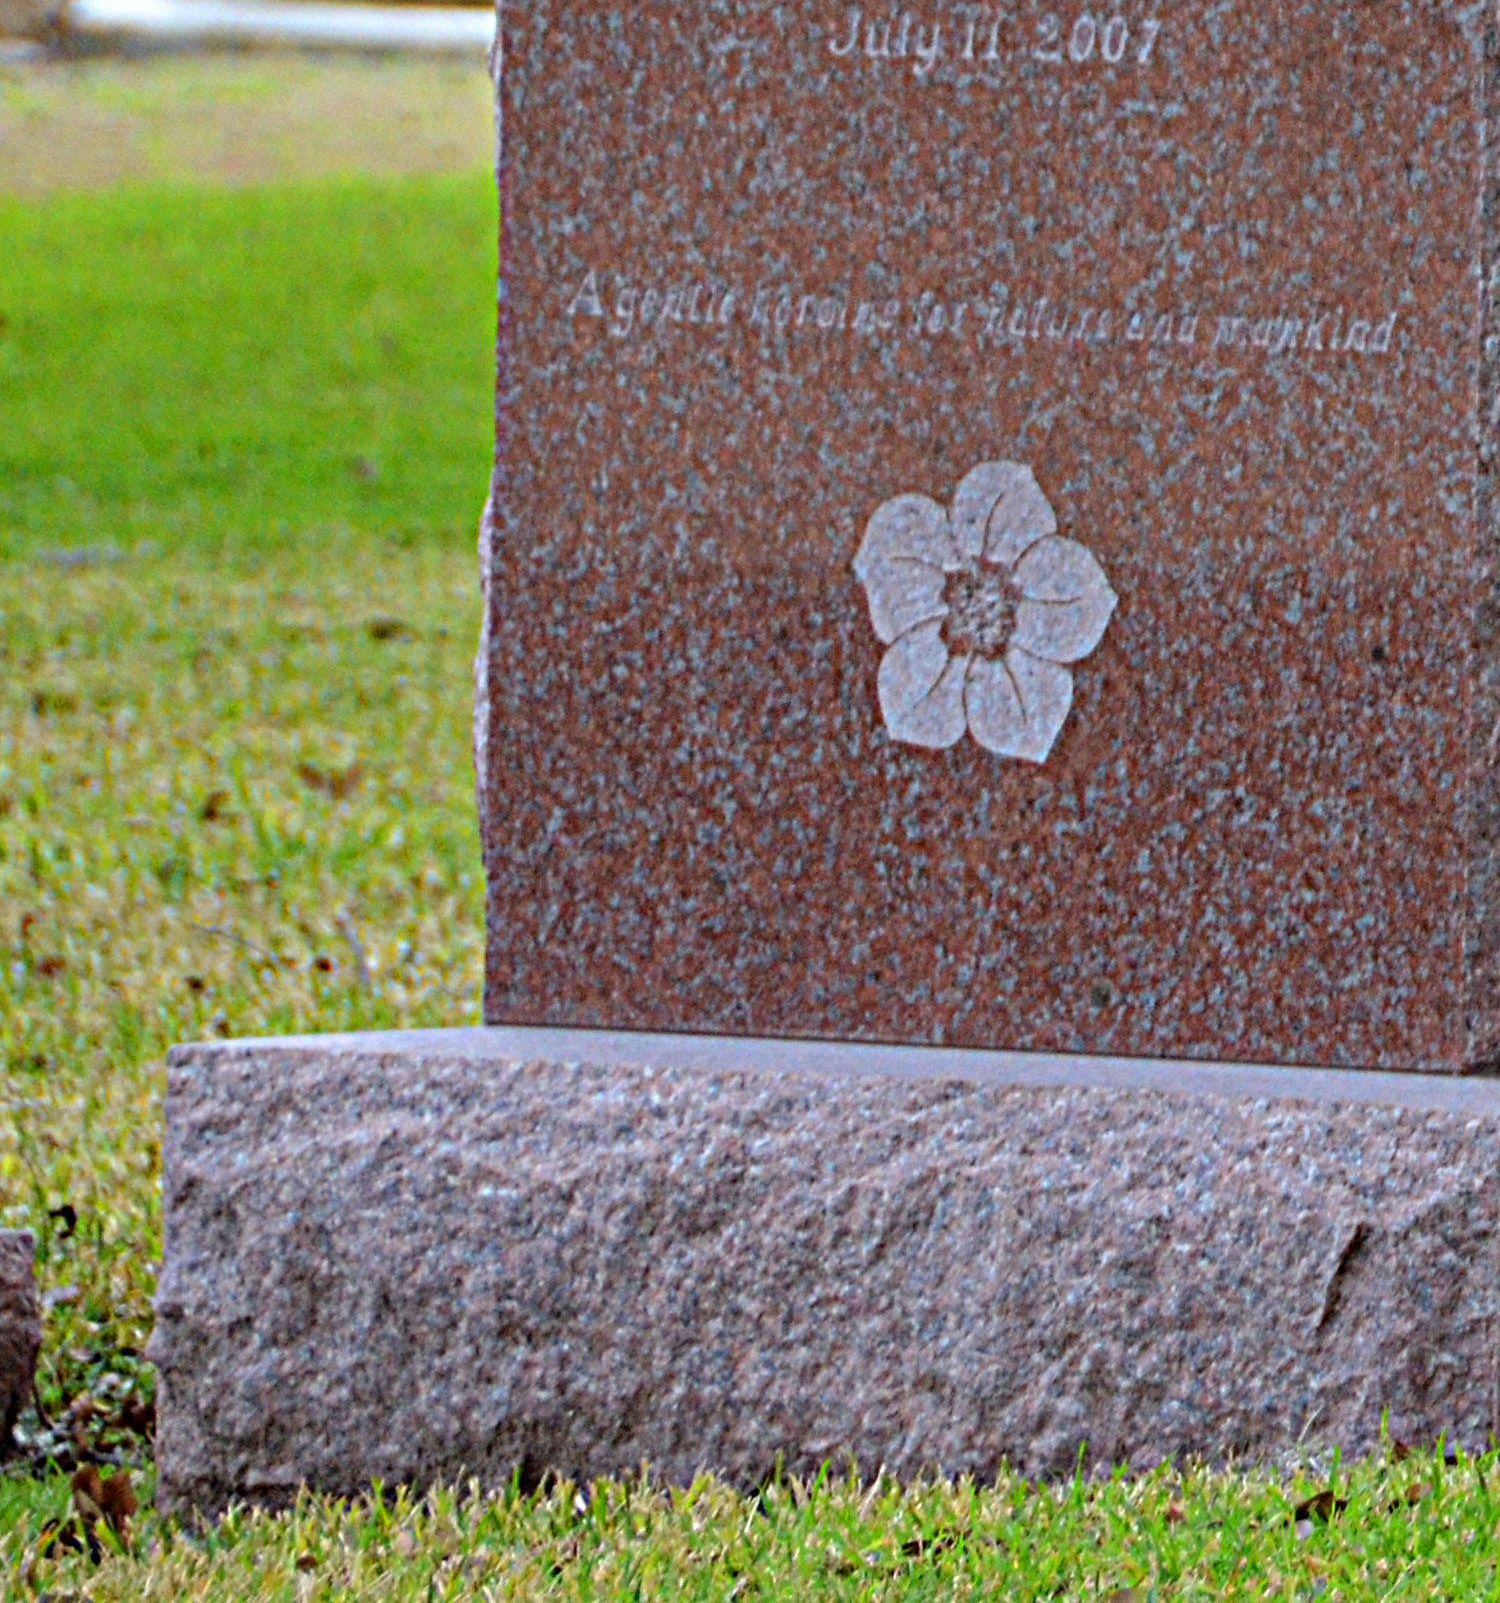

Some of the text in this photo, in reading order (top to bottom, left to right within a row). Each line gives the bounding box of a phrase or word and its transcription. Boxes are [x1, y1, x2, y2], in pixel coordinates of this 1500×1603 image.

[829, 4, 941, 76] July
[1034, 12, 1162, 65] 2007
[567, 270, 603, 316] A
